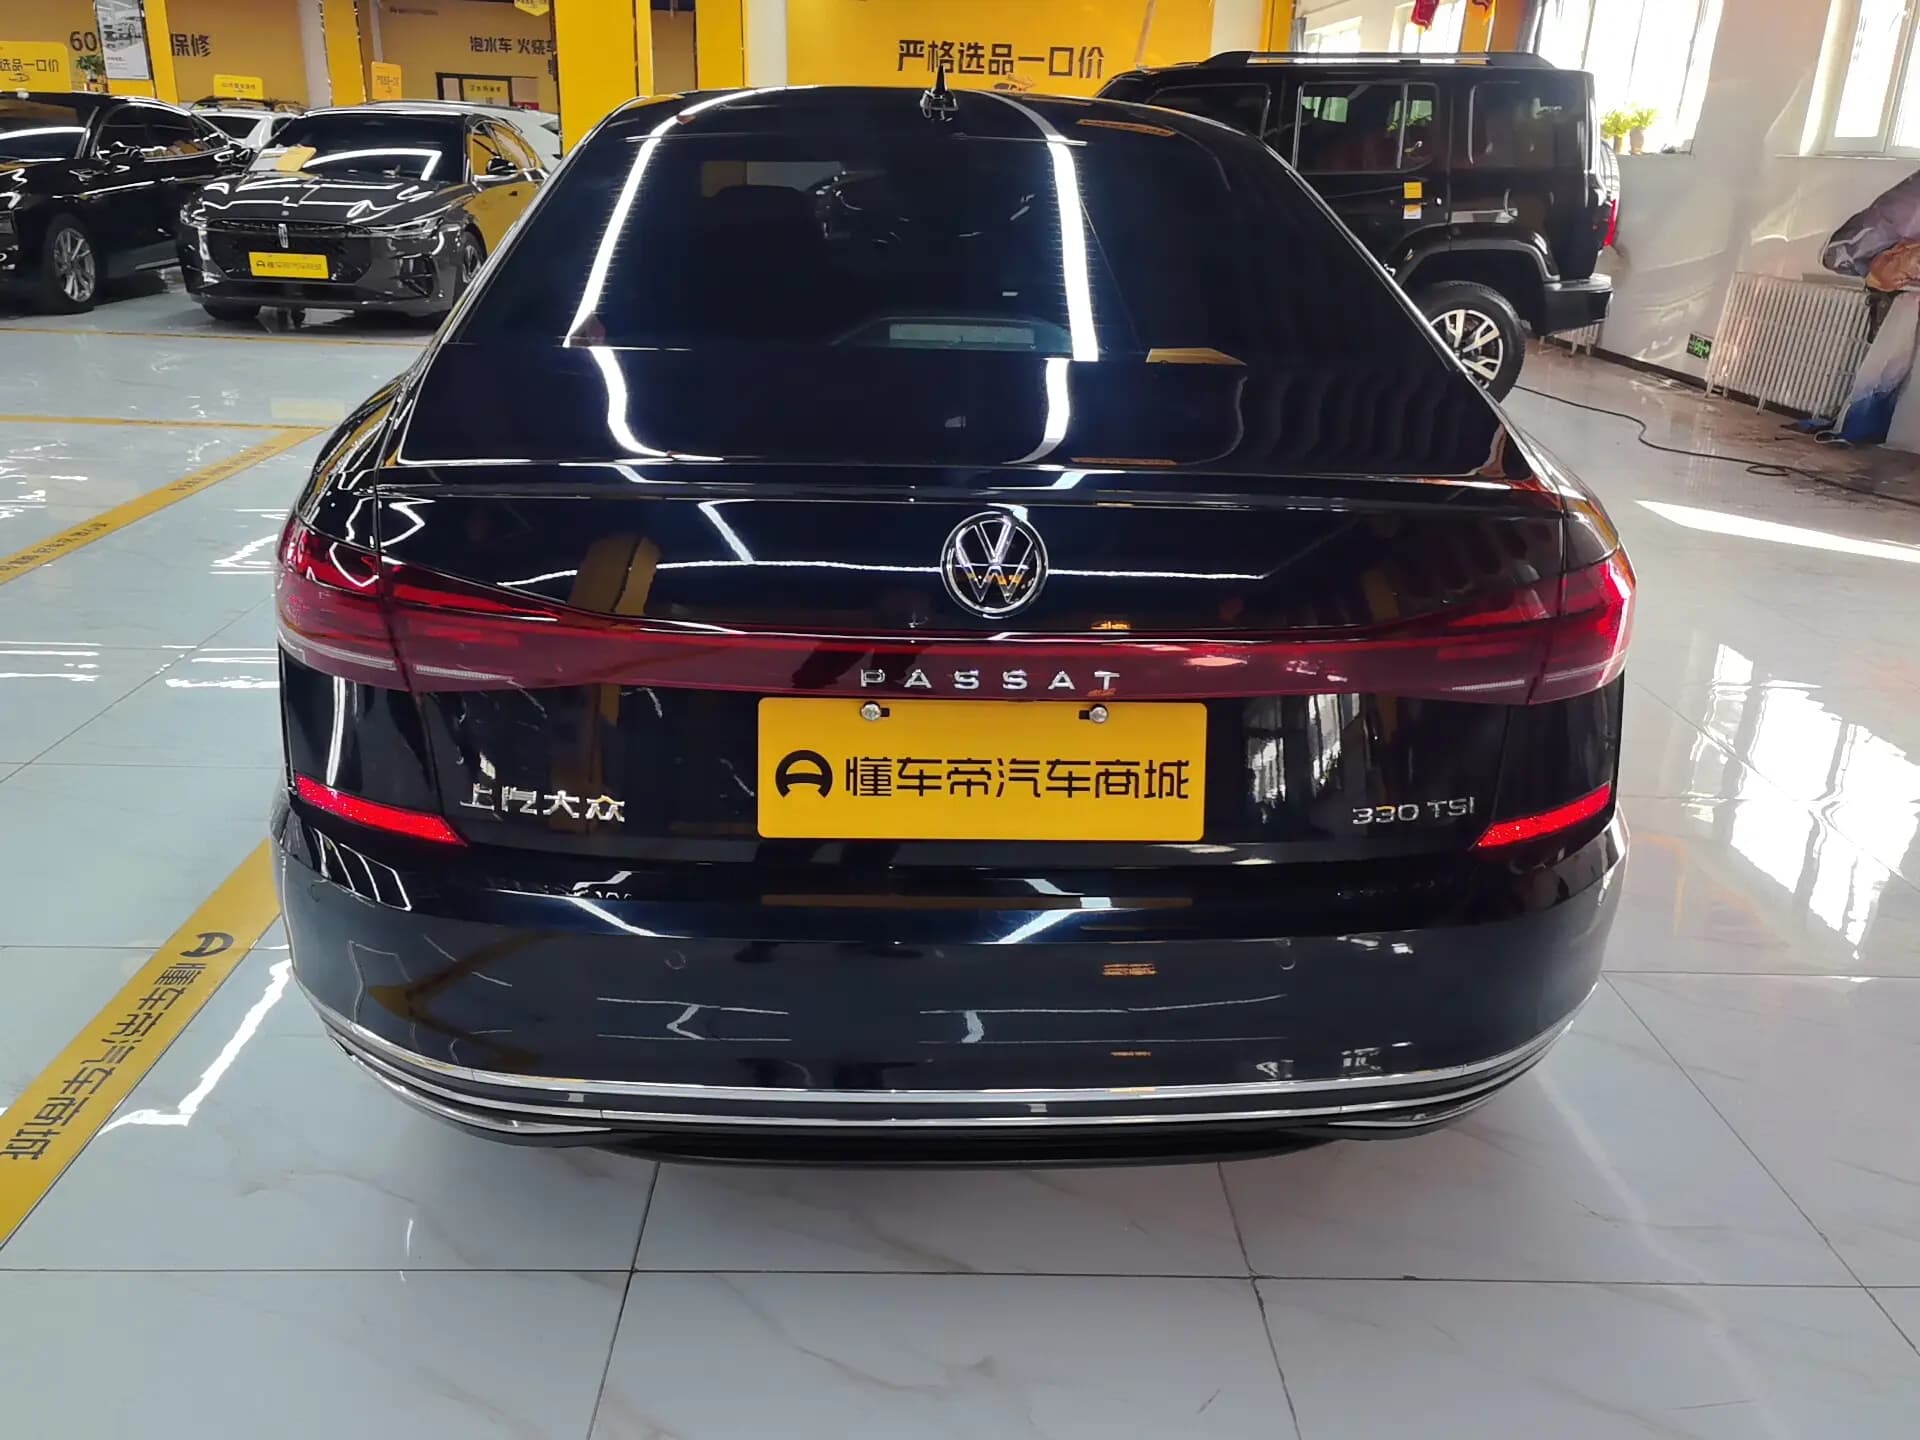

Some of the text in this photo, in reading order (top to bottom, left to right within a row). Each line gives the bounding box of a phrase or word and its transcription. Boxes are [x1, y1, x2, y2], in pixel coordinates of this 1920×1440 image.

[69, 31, 98, 51] 60
[170, 33, 211, 57] 保修
[470, 35, 513, 52] 泡水车
[897, 39, 1105, 78] 严格选品一口价
[860, 668, 1121, 691] PASSAT
[845, 756, 1190, 800] 懂车帝汽车商城
[460, 783, 626, 822] 上汽大众
[1352, 796, 1475, 825] 330 TSI
